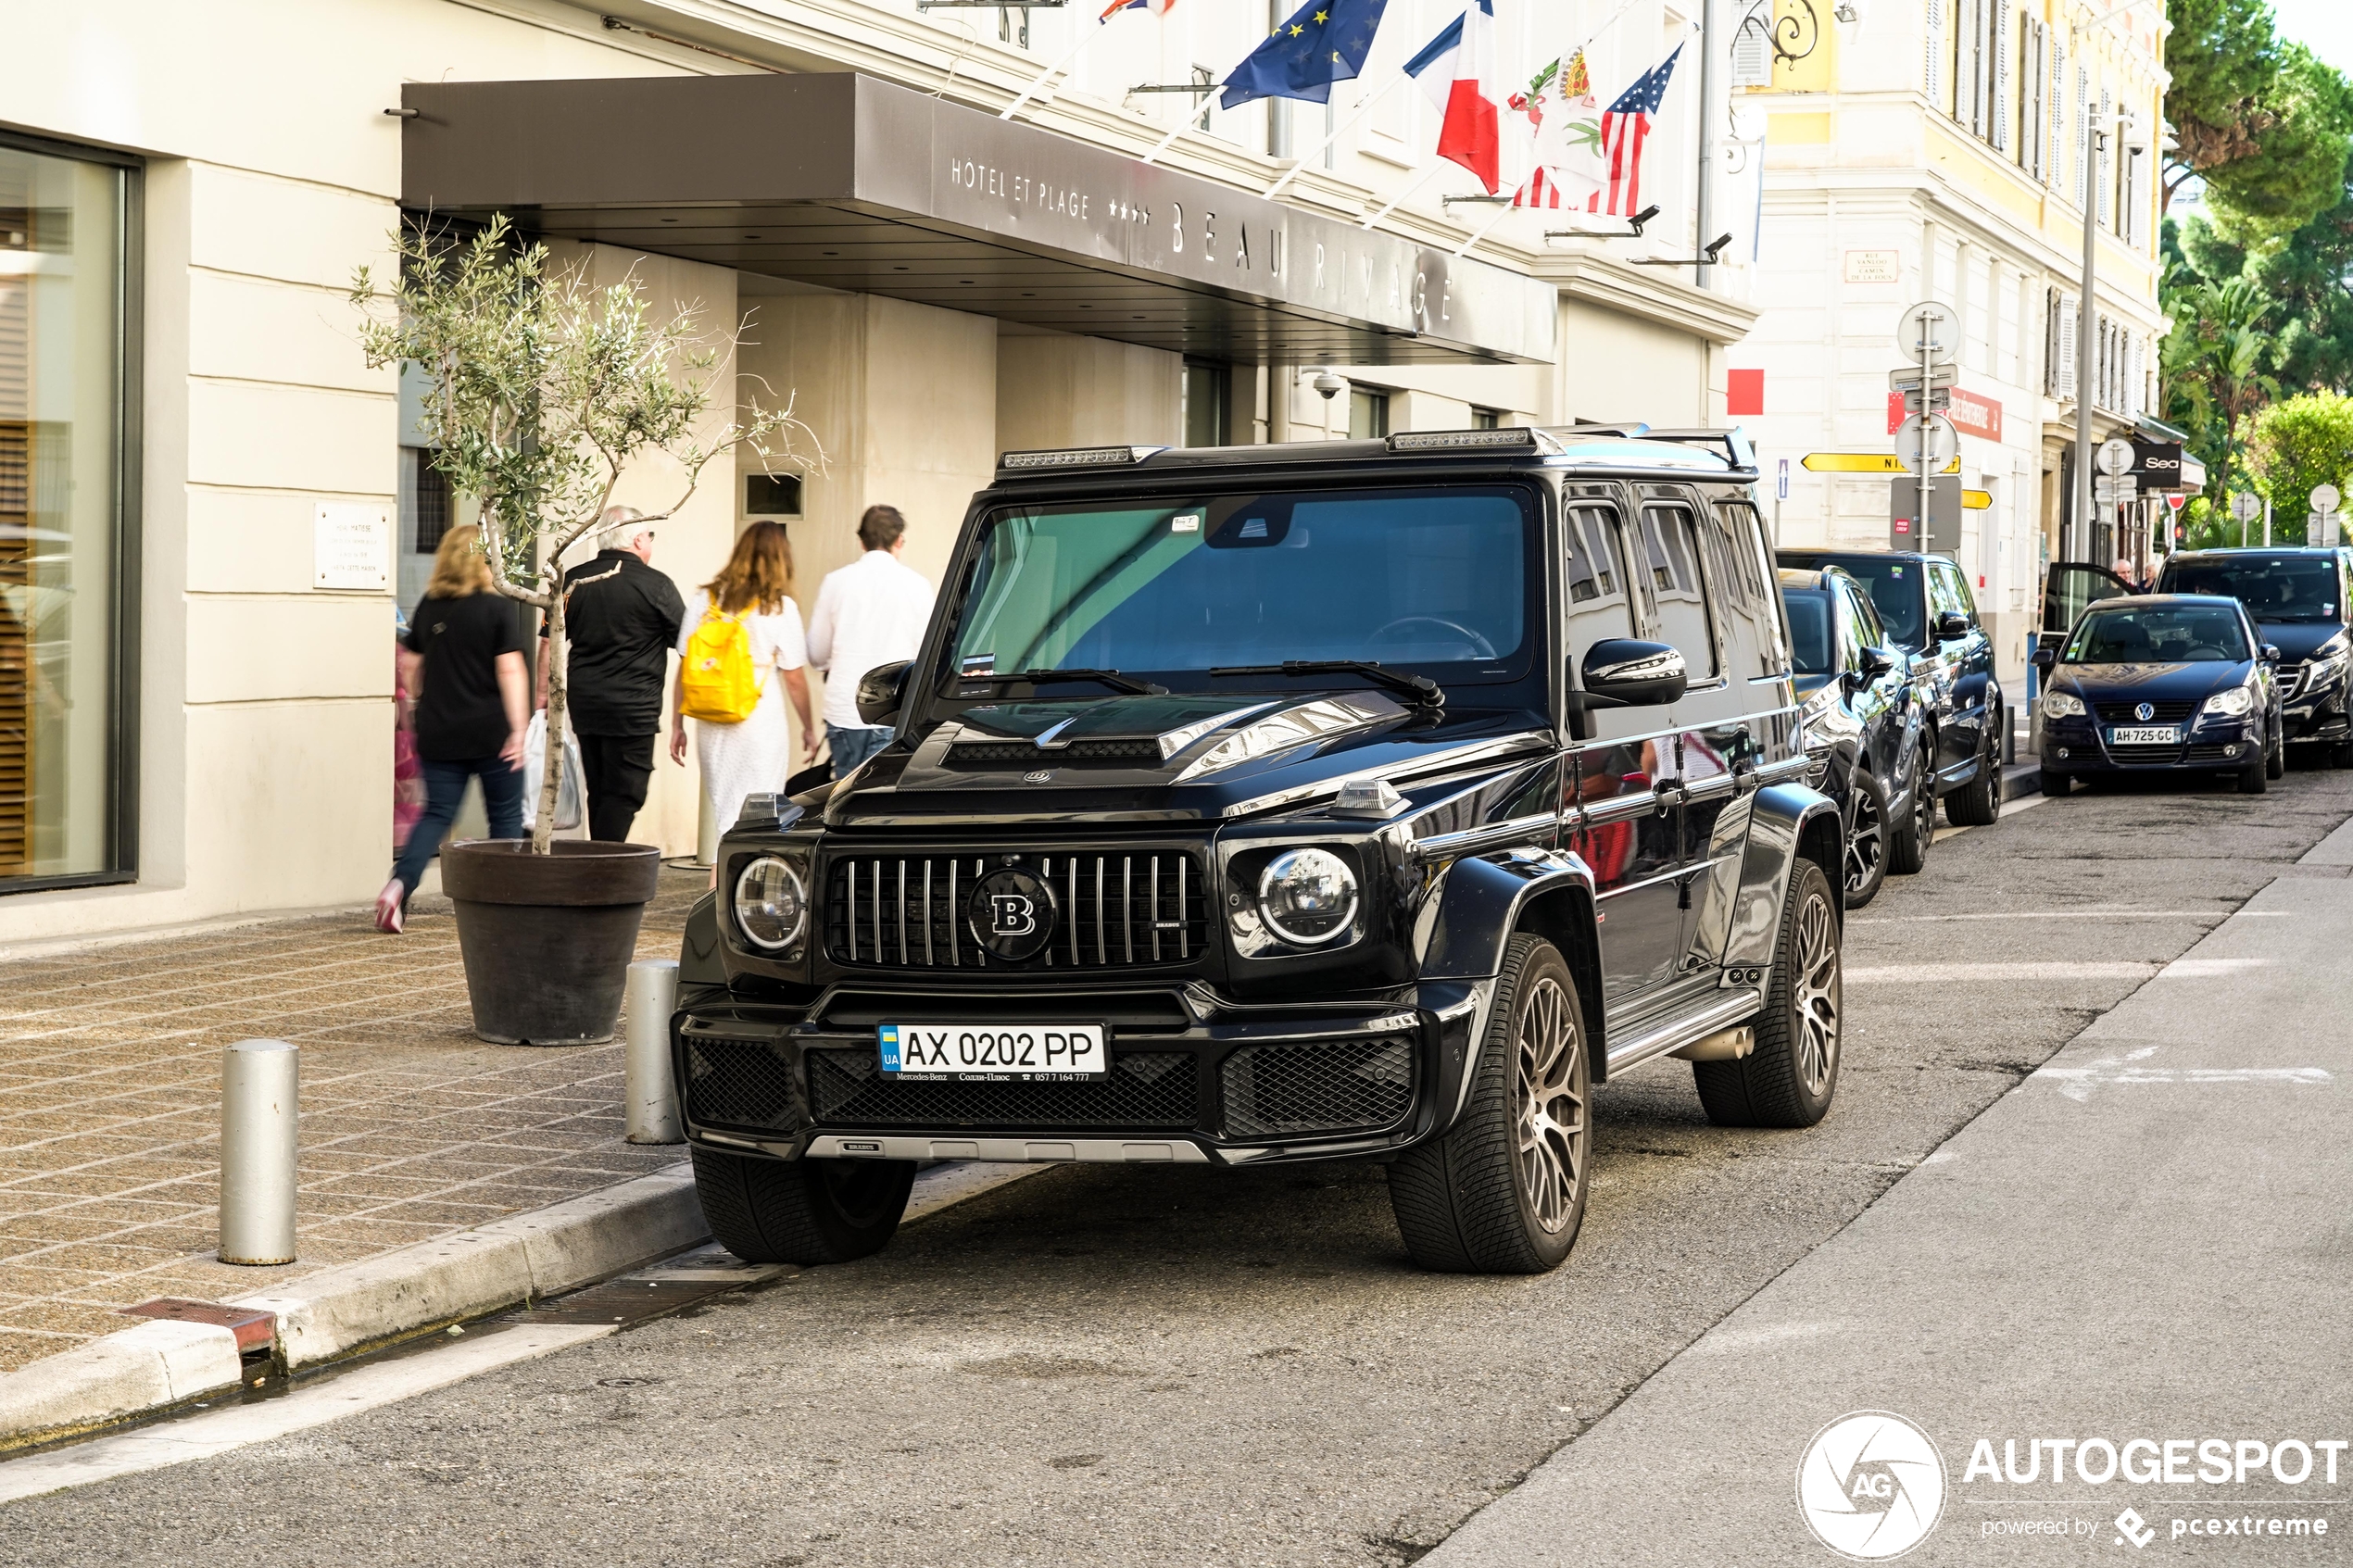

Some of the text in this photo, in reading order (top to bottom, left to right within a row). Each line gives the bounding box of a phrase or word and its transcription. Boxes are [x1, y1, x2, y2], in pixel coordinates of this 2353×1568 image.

[1015, 176, 1030, 203] ET
[1039, 182, 1088, 220] PLAGE
[1173, 202, 1281, 278] BEAU
[1315, 243, 1452, 321] RIVAGE
[2145, 458, 2179, 469] Sea
[2116, 730, 2171, 741] AH-725-GC
[905, 1033, 1092, 1066] AX 0202 PP
[885, 1055, 899, 1064] UA
